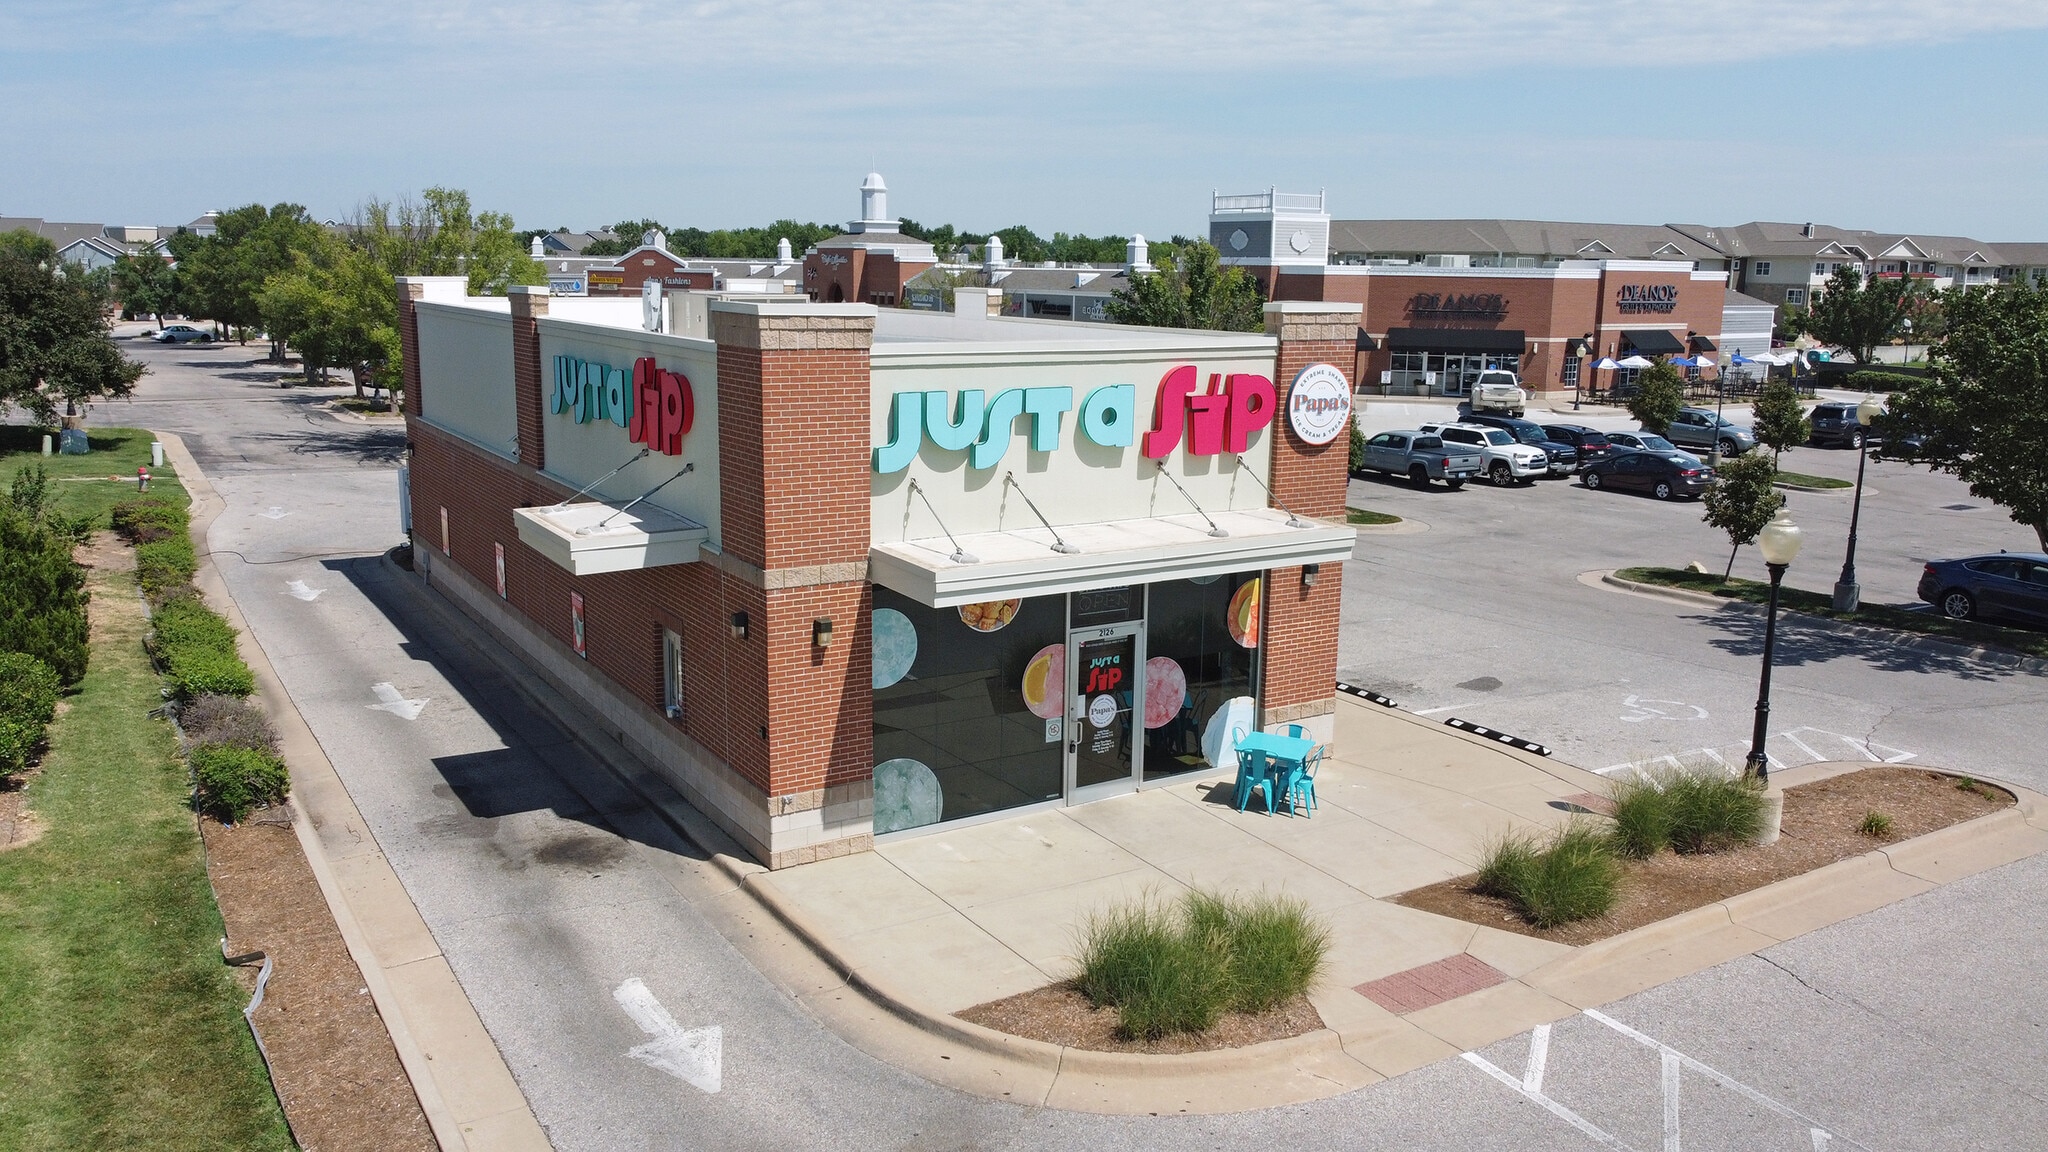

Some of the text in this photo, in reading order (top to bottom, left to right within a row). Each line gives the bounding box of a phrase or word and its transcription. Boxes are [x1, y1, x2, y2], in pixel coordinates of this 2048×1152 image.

[1300, 370, 1346, 390] EXTREME SHAKES
[1293, 394, 1349, 416] Papa's
[1294, 415, 1302, 427] ICE
[1301, 427, 1321, 438] CREAM
[1099, 629, 1115, 637] 2126
